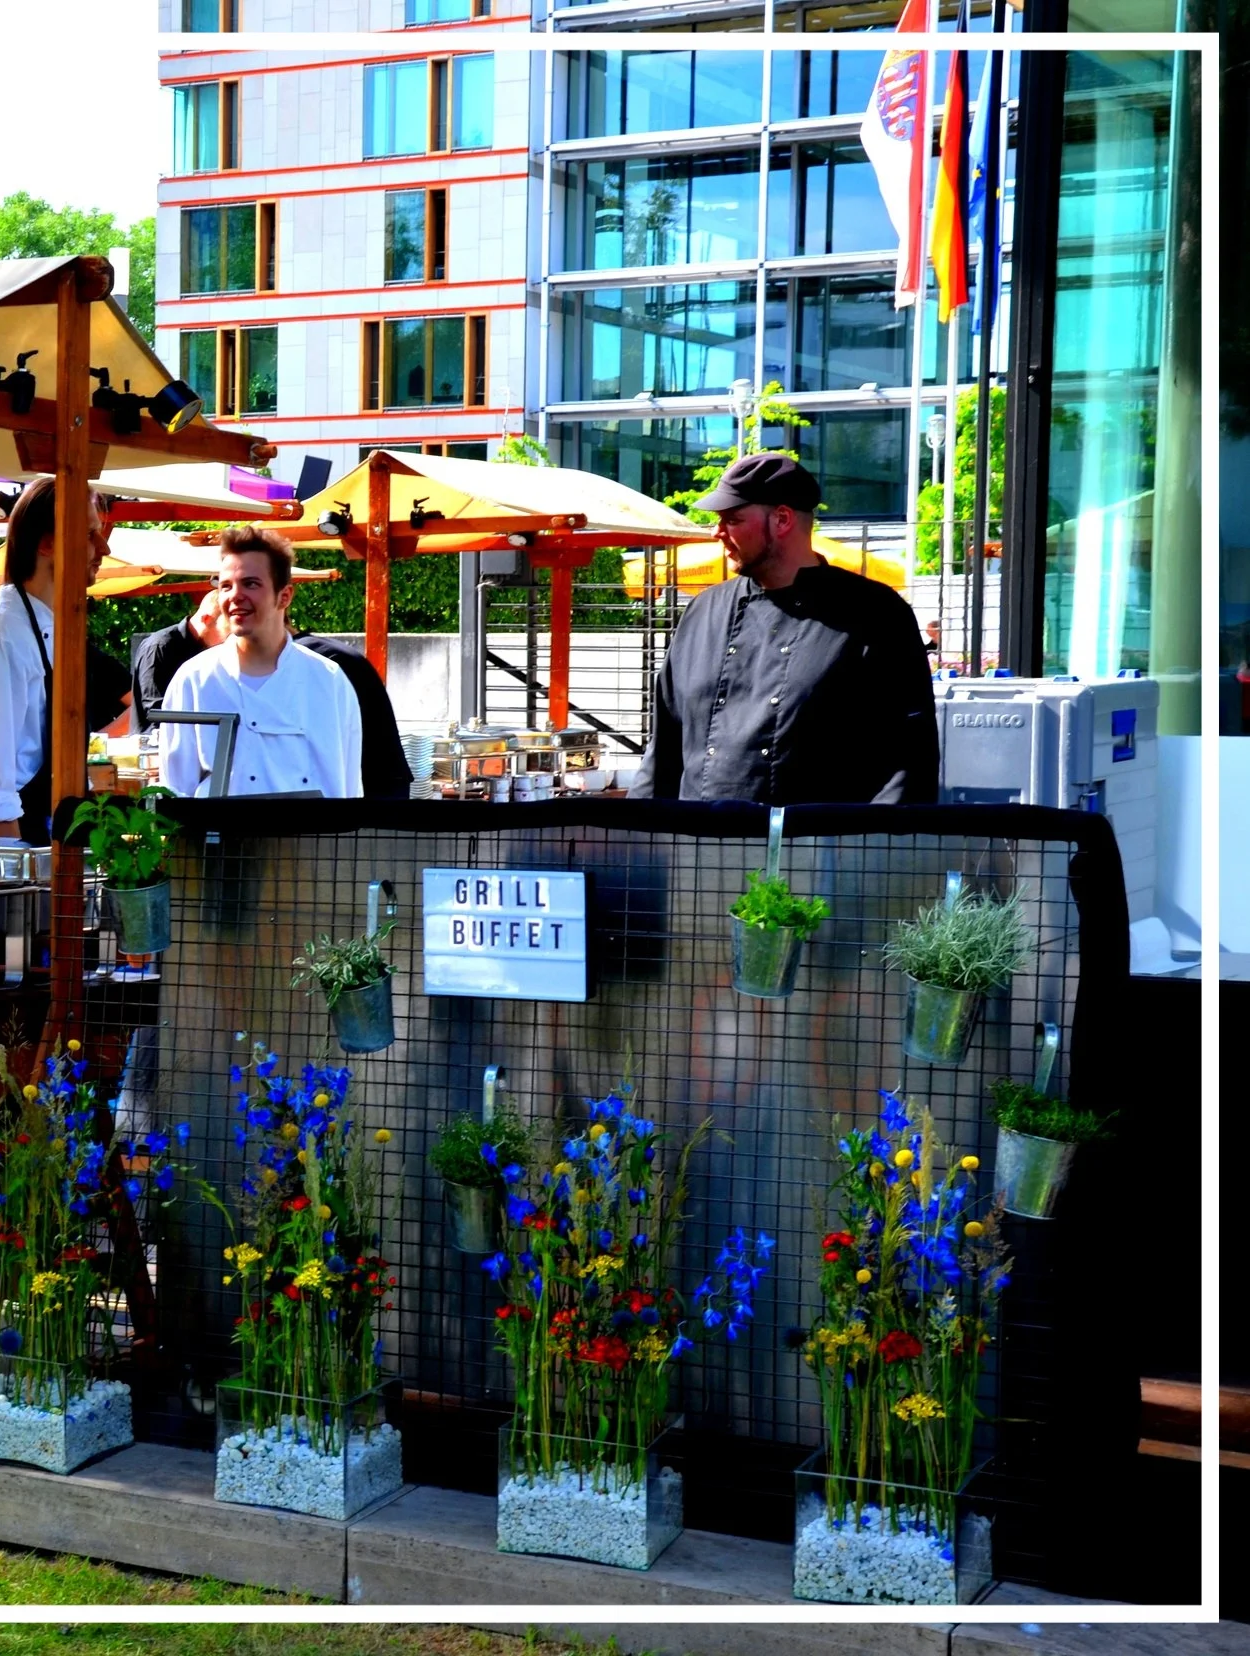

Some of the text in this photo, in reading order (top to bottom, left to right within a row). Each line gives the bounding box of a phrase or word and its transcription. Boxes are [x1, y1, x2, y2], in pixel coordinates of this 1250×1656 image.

[952, 713, 1025, 728] BLANCO
[455, 879, 546, 908] GRILL
[452, 919, 563, 949] BUFFET
